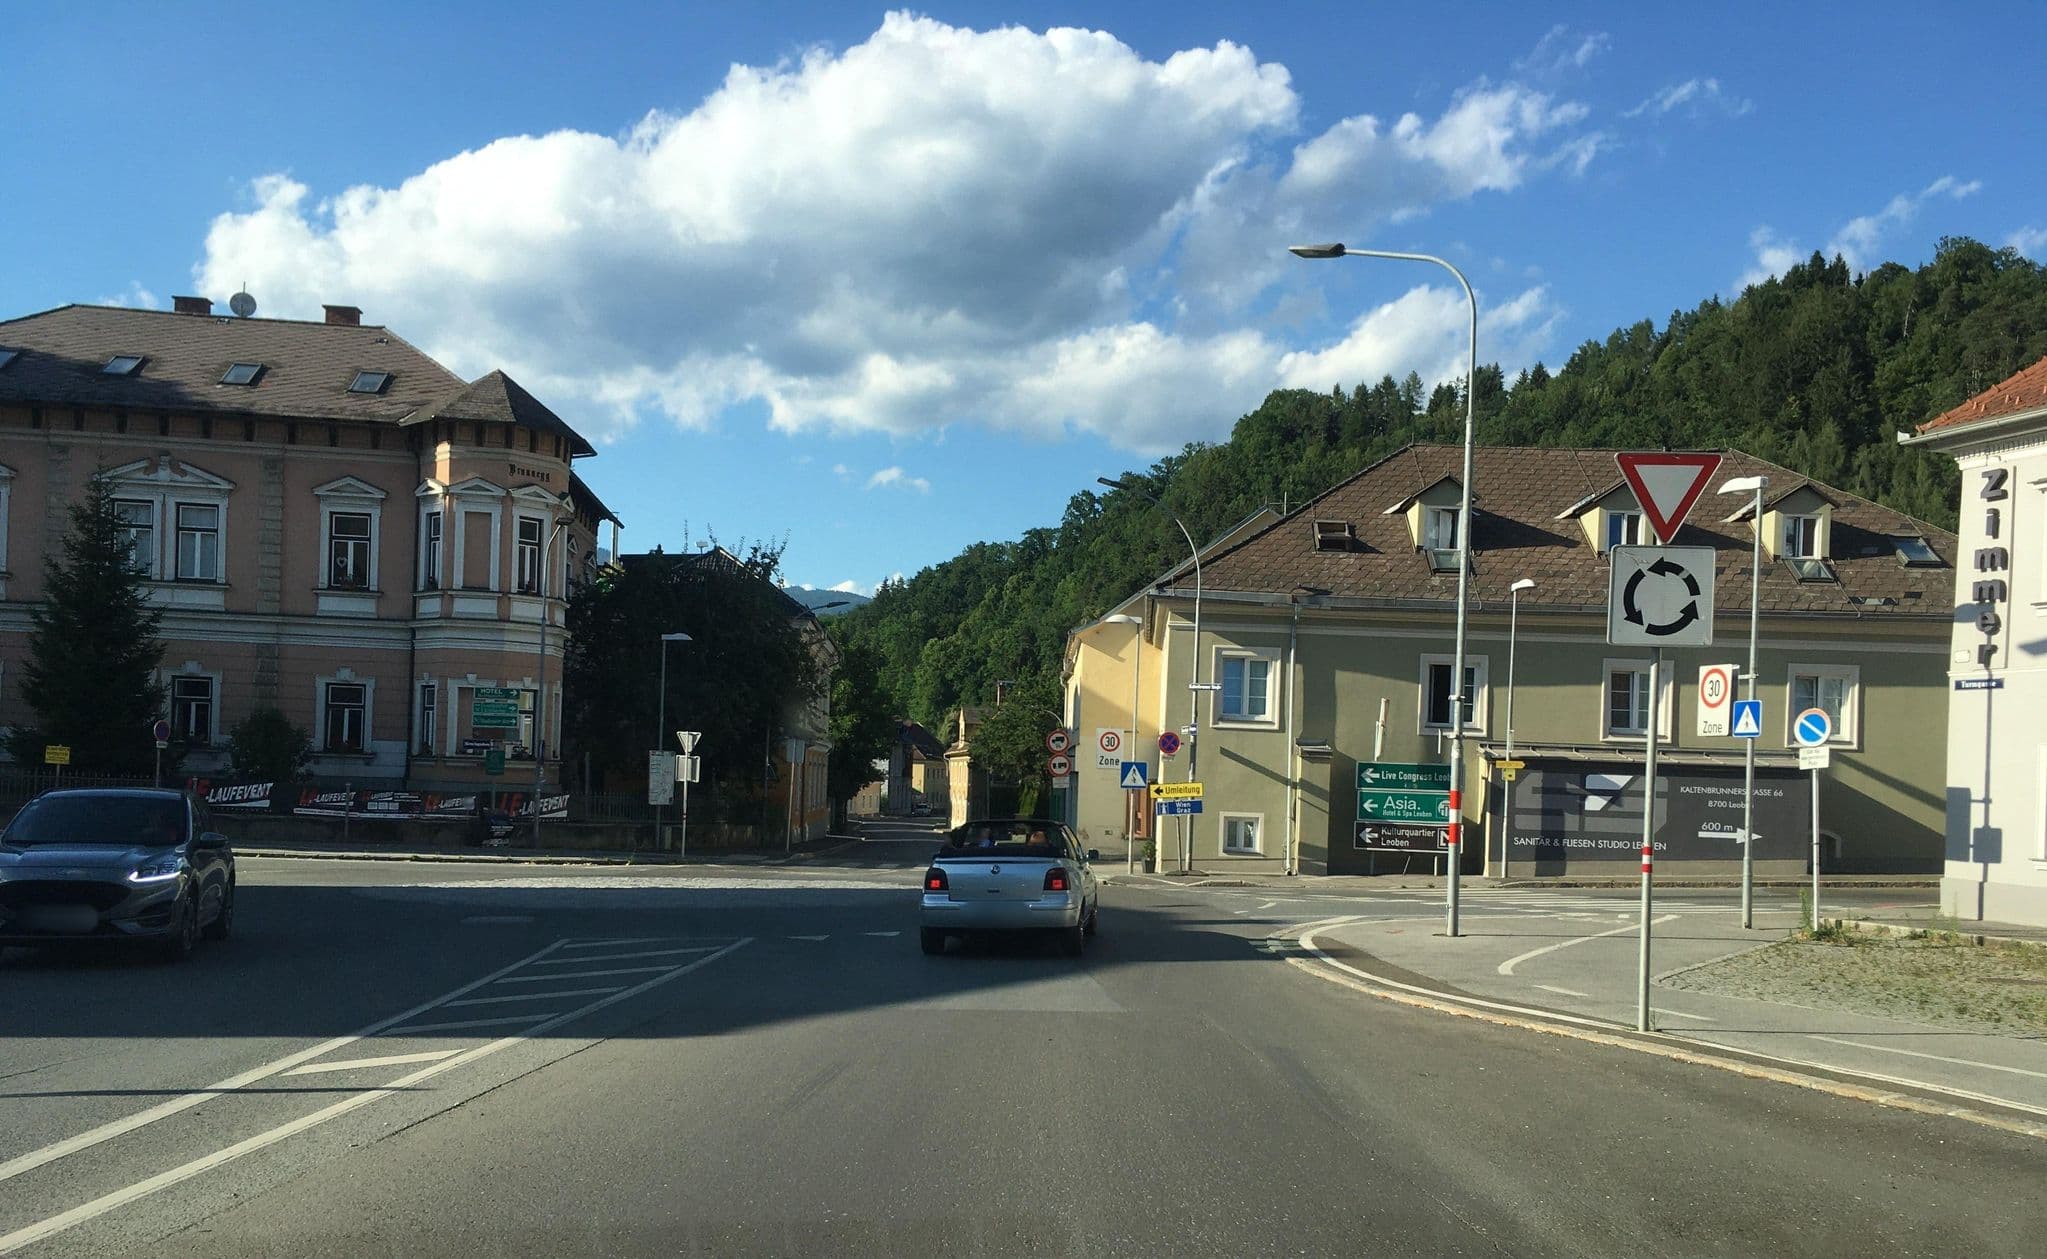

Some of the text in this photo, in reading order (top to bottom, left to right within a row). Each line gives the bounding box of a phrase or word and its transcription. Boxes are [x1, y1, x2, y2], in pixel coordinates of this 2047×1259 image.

[1972, 468, 2008, 668] Zimmer
[1708, 680, 1720, 697] 30
[1703, 721, 1723, 733] Zone
[1105, 736, 1115, 748] 30
[1099, 756, 1120, 766] Zone
[1381, 771, 1396, 780] Live
[1398, 771, 1432, 782] Congress
[1165, 786, 1200, 795] Umleitung
[1680, 786, 1784, 797] KALTENBRUNNERSASSE 66
[1708, 800, 1727, 808] 8700
[1381, 827, 1436, 837] Kulturquartier
[1701, 822, 1721, 831] 600
[1381, 838, 1410, 847] Leoben
[1513, 836, 1667, 850] SANITÄR & FLIESEN STUDIO LEEN
